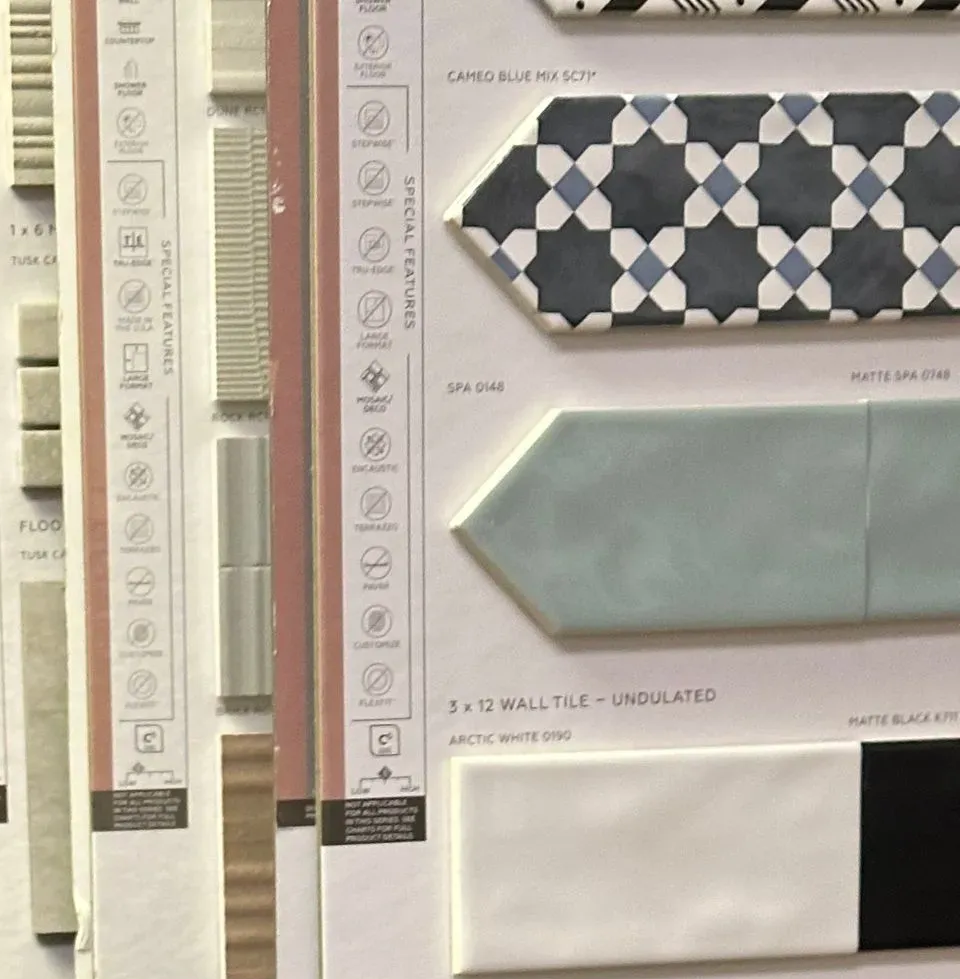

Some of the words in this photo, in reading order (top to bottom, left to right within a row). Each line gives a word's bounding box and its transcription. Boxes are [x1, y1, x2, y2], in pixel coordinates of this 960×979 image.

[447, 70, 494, 83] CAMEO
[498, 69, 532, 82] BLUE
[536, 69, 560, 82] MIX
[404, 175, 416, 243] SPECIAL
[10, 224, 16, 236] 1
[43, 255, 57, 266] CA
[161, 240, 172, 298] SPECIAL
[404, 248, 416, 330] FEATURES
[162, 303, 174, 375] FEATURES
[851, 369, 891, 382] MATTE
[894, 369, 918, 382] SPA
[447, 382, 472, 394] SPA
[475, 381, 505, 393] 0148
[20, 519, 61, 532] FLOO
[52, 551, 67, 560] CA
[448, 700, 457, 713] 3
[462, 703, 473, 713] x
[478, 698, 494, 713] 12
[500, 696, 550, 712] WALL
[552, 693, 589, 709] TILE
[612, 688, 717, 707] UNDULATED
[848, 715, 888, 727] MATTE
[892, 712, 931, 726] BLACK
[448, 733, 494, 746] ARCTIC
[498, 731, 539, 744] WHITE
[542, 730, 572, 742] 0190
